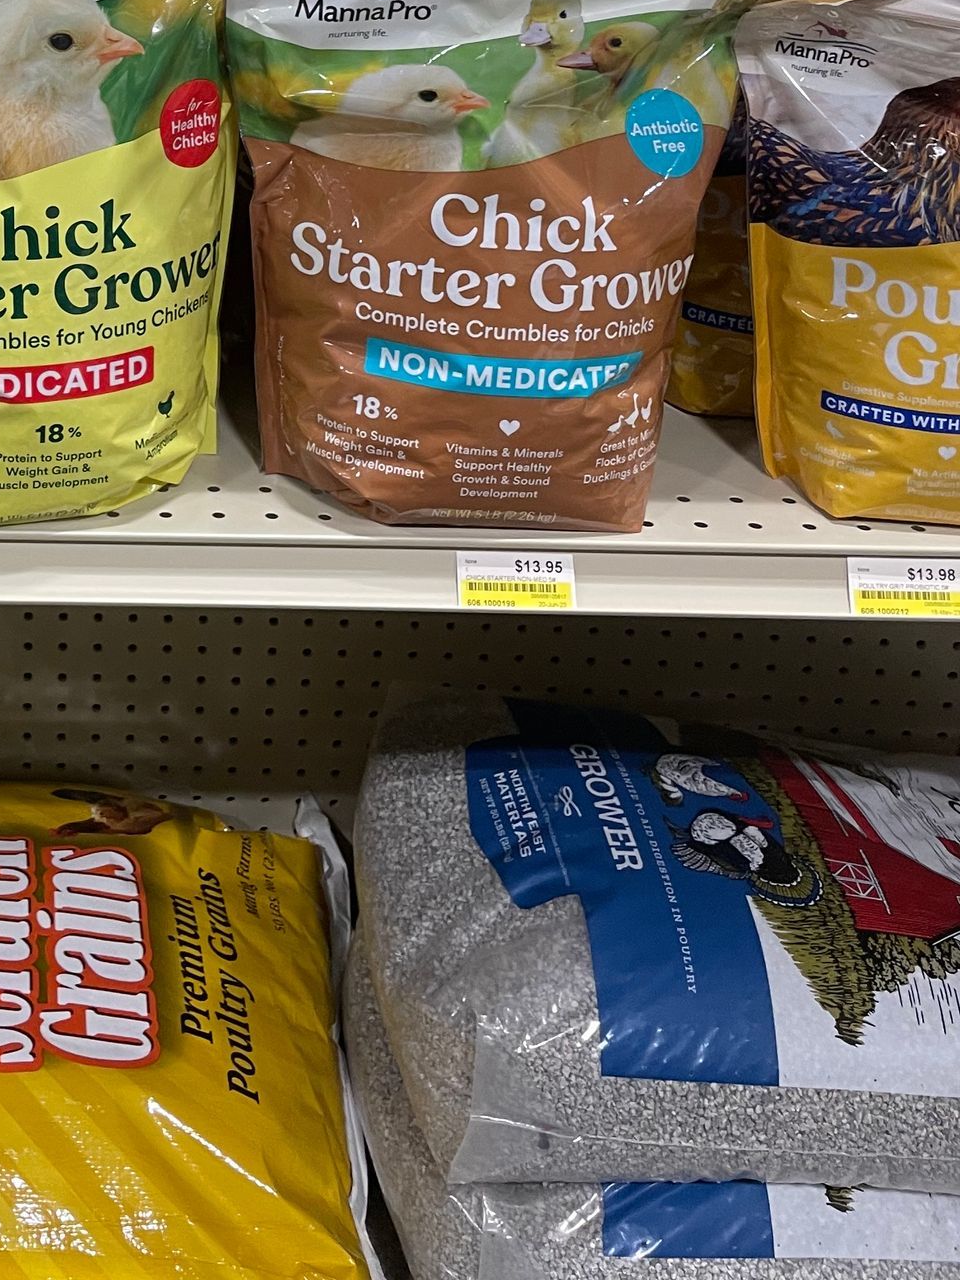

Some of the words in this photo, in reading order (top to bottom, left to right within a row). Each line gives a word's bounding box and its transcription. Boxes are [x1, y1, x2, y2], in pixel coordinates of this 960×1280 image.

[327, 28, 371, 40] nurturing
[775, 39, 870, 69] MannaPro
[170, 111, 218, 135] Healthy
[171, 130, 216, 152] Chicks
[652, 139, 686, 154] Free
[430, 193, 618, 254] Chick
[54, 231, 220, 316] Grower
[290, 221, 517, 311] Starter
[56, 328, 85, 348] for
[89, 316, 147, 343] Young
[151, 291, 209, 327] Chickens
[355, 302, 461, 336] Complete
[465, 319, 570, 343] Crumbles
[574, 321, 602, 342] for
[604, 316, 655, 338] Chicks
[842, 381, 894, 401] Digestive
[825, 396, 905, 424] CRAFTED
[912, 414, 959, 431] WITH
[370, 430, 420, 449] Support
[446, 443, 498, 457] Vitamins
[514, 448, 564, 459] Minerals
[55, 448, 103, 463] Support
[345, 454, 425, 480] Development
[454, 459, 503, 472] Support
[506, 463, 552, 474] Healthy
[6, 466, 49, 478] Weight
[32, 474, 110, 490] Development
[451, 473, 497, 485] Growth
[512, 476, 550, 486] Sound
[459, 488, 539, 500] Development
[515, 560, 563, 574] $13.95
[907, 568, 956, 581] $13.98
[493, 771, 532, 858] MATERIALS
[569, 743, 645, 871] GROWER
[198, 868, 238, 963] Grains
[648, 839, 677, 904] DIGESTION
[676, 926, 697, 995] POULTRY
[37, 848, 153, 1062] Grains
[169, 893, 214, 1044] Premium
[215, 970, 260, 1104] Poultry
